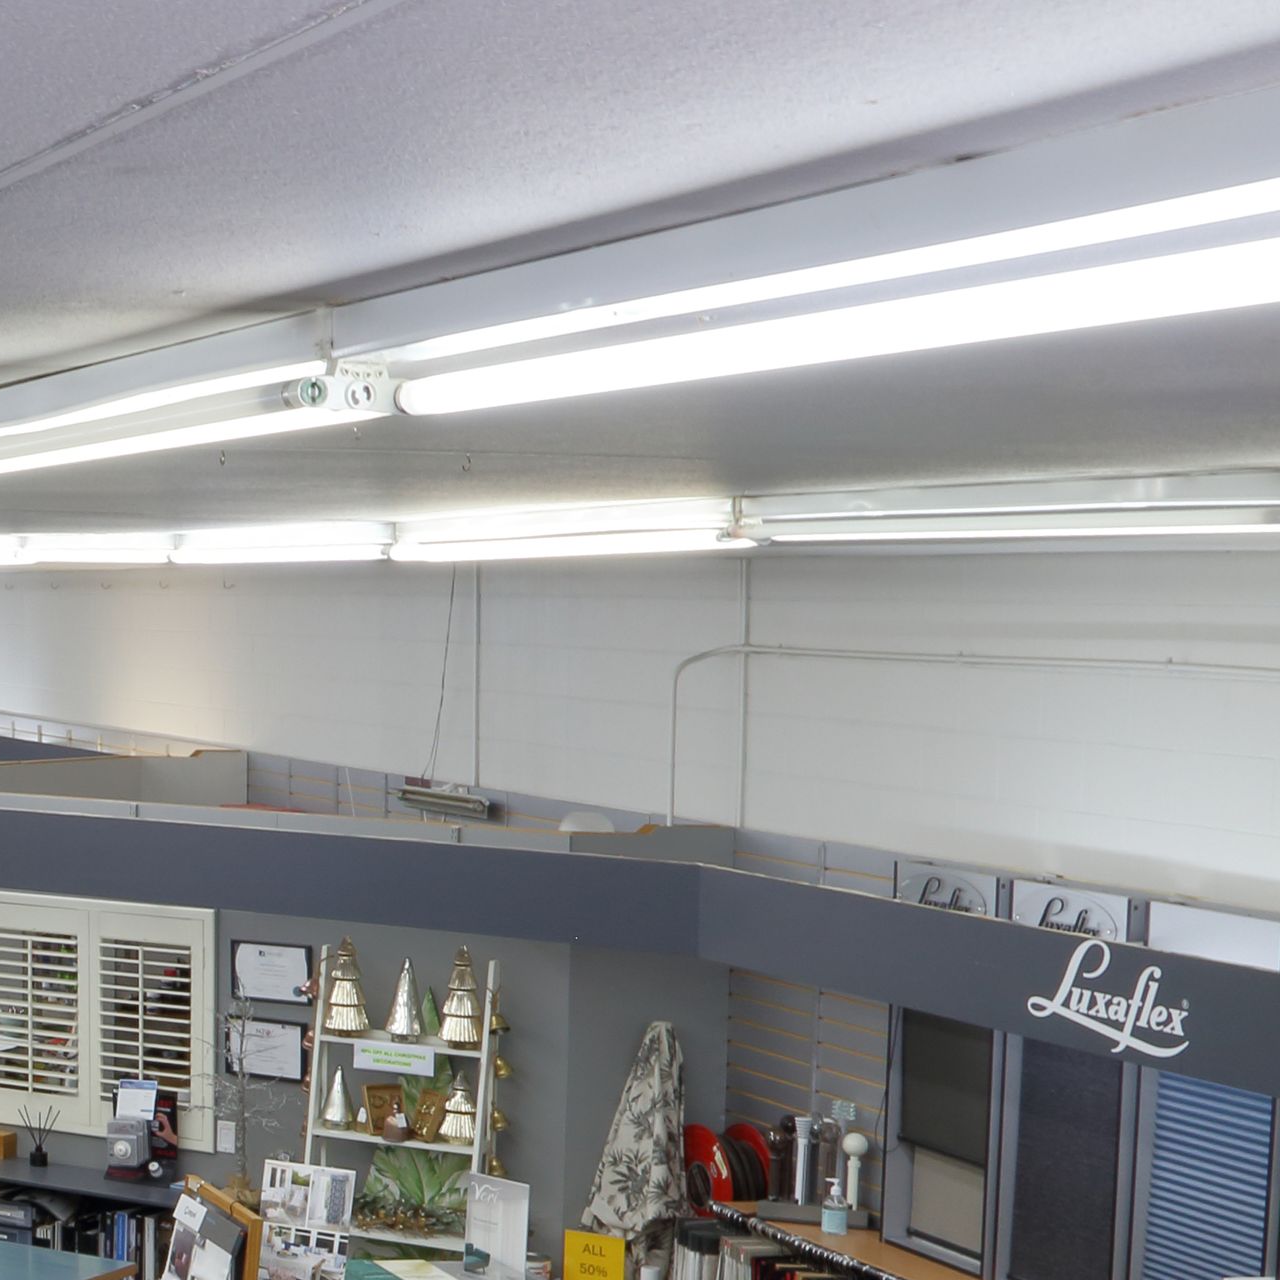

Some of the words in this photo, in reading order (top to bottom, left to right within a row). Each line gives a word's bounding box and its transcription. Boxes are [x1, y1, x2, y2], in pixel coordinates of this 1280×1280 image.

[1027, 939, 1190, 1058] Luxaflex
[582, 1243, 606, 1258] ALL
[580, 1264, 608, 1278] 50%
